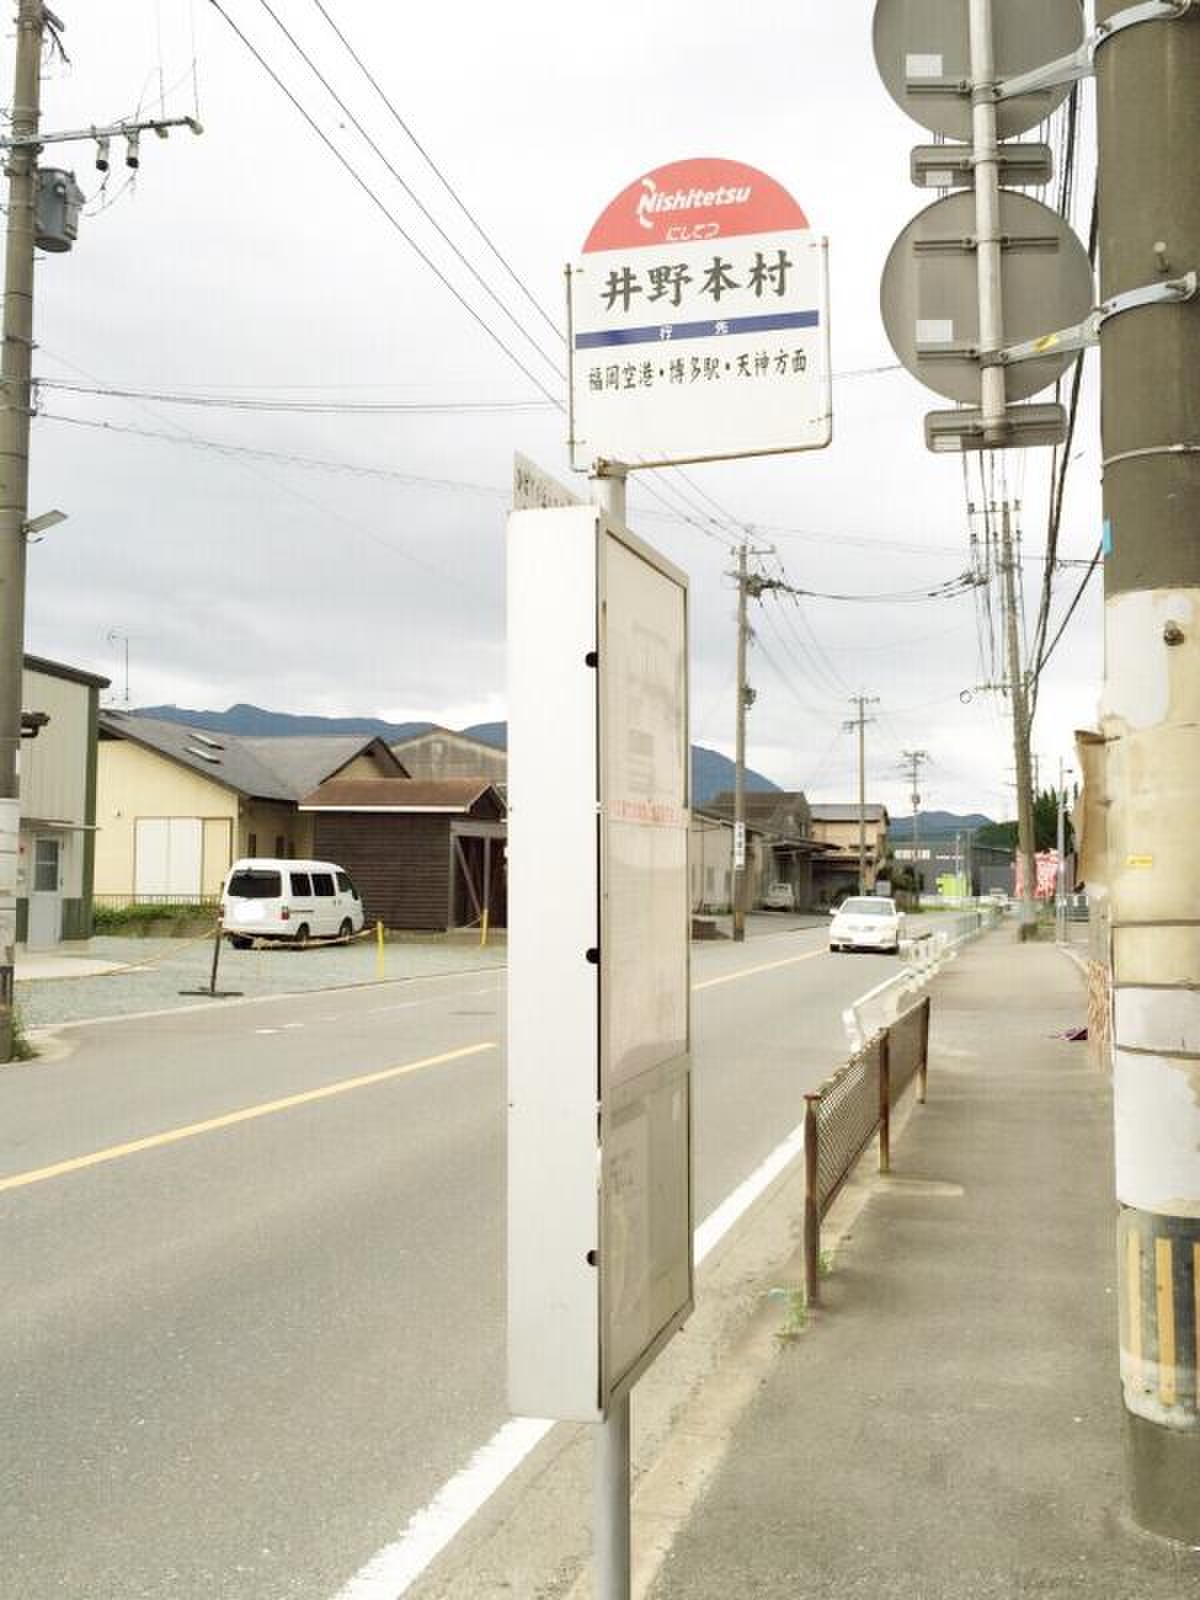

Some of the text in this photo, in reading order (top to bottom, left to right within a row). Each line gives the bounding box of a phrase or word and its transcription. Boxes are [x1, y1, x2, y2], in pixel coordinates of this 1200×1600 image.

[636, 183, 752, 215] Nishitetsu
[600, 249, 793, 312] 井野本村
